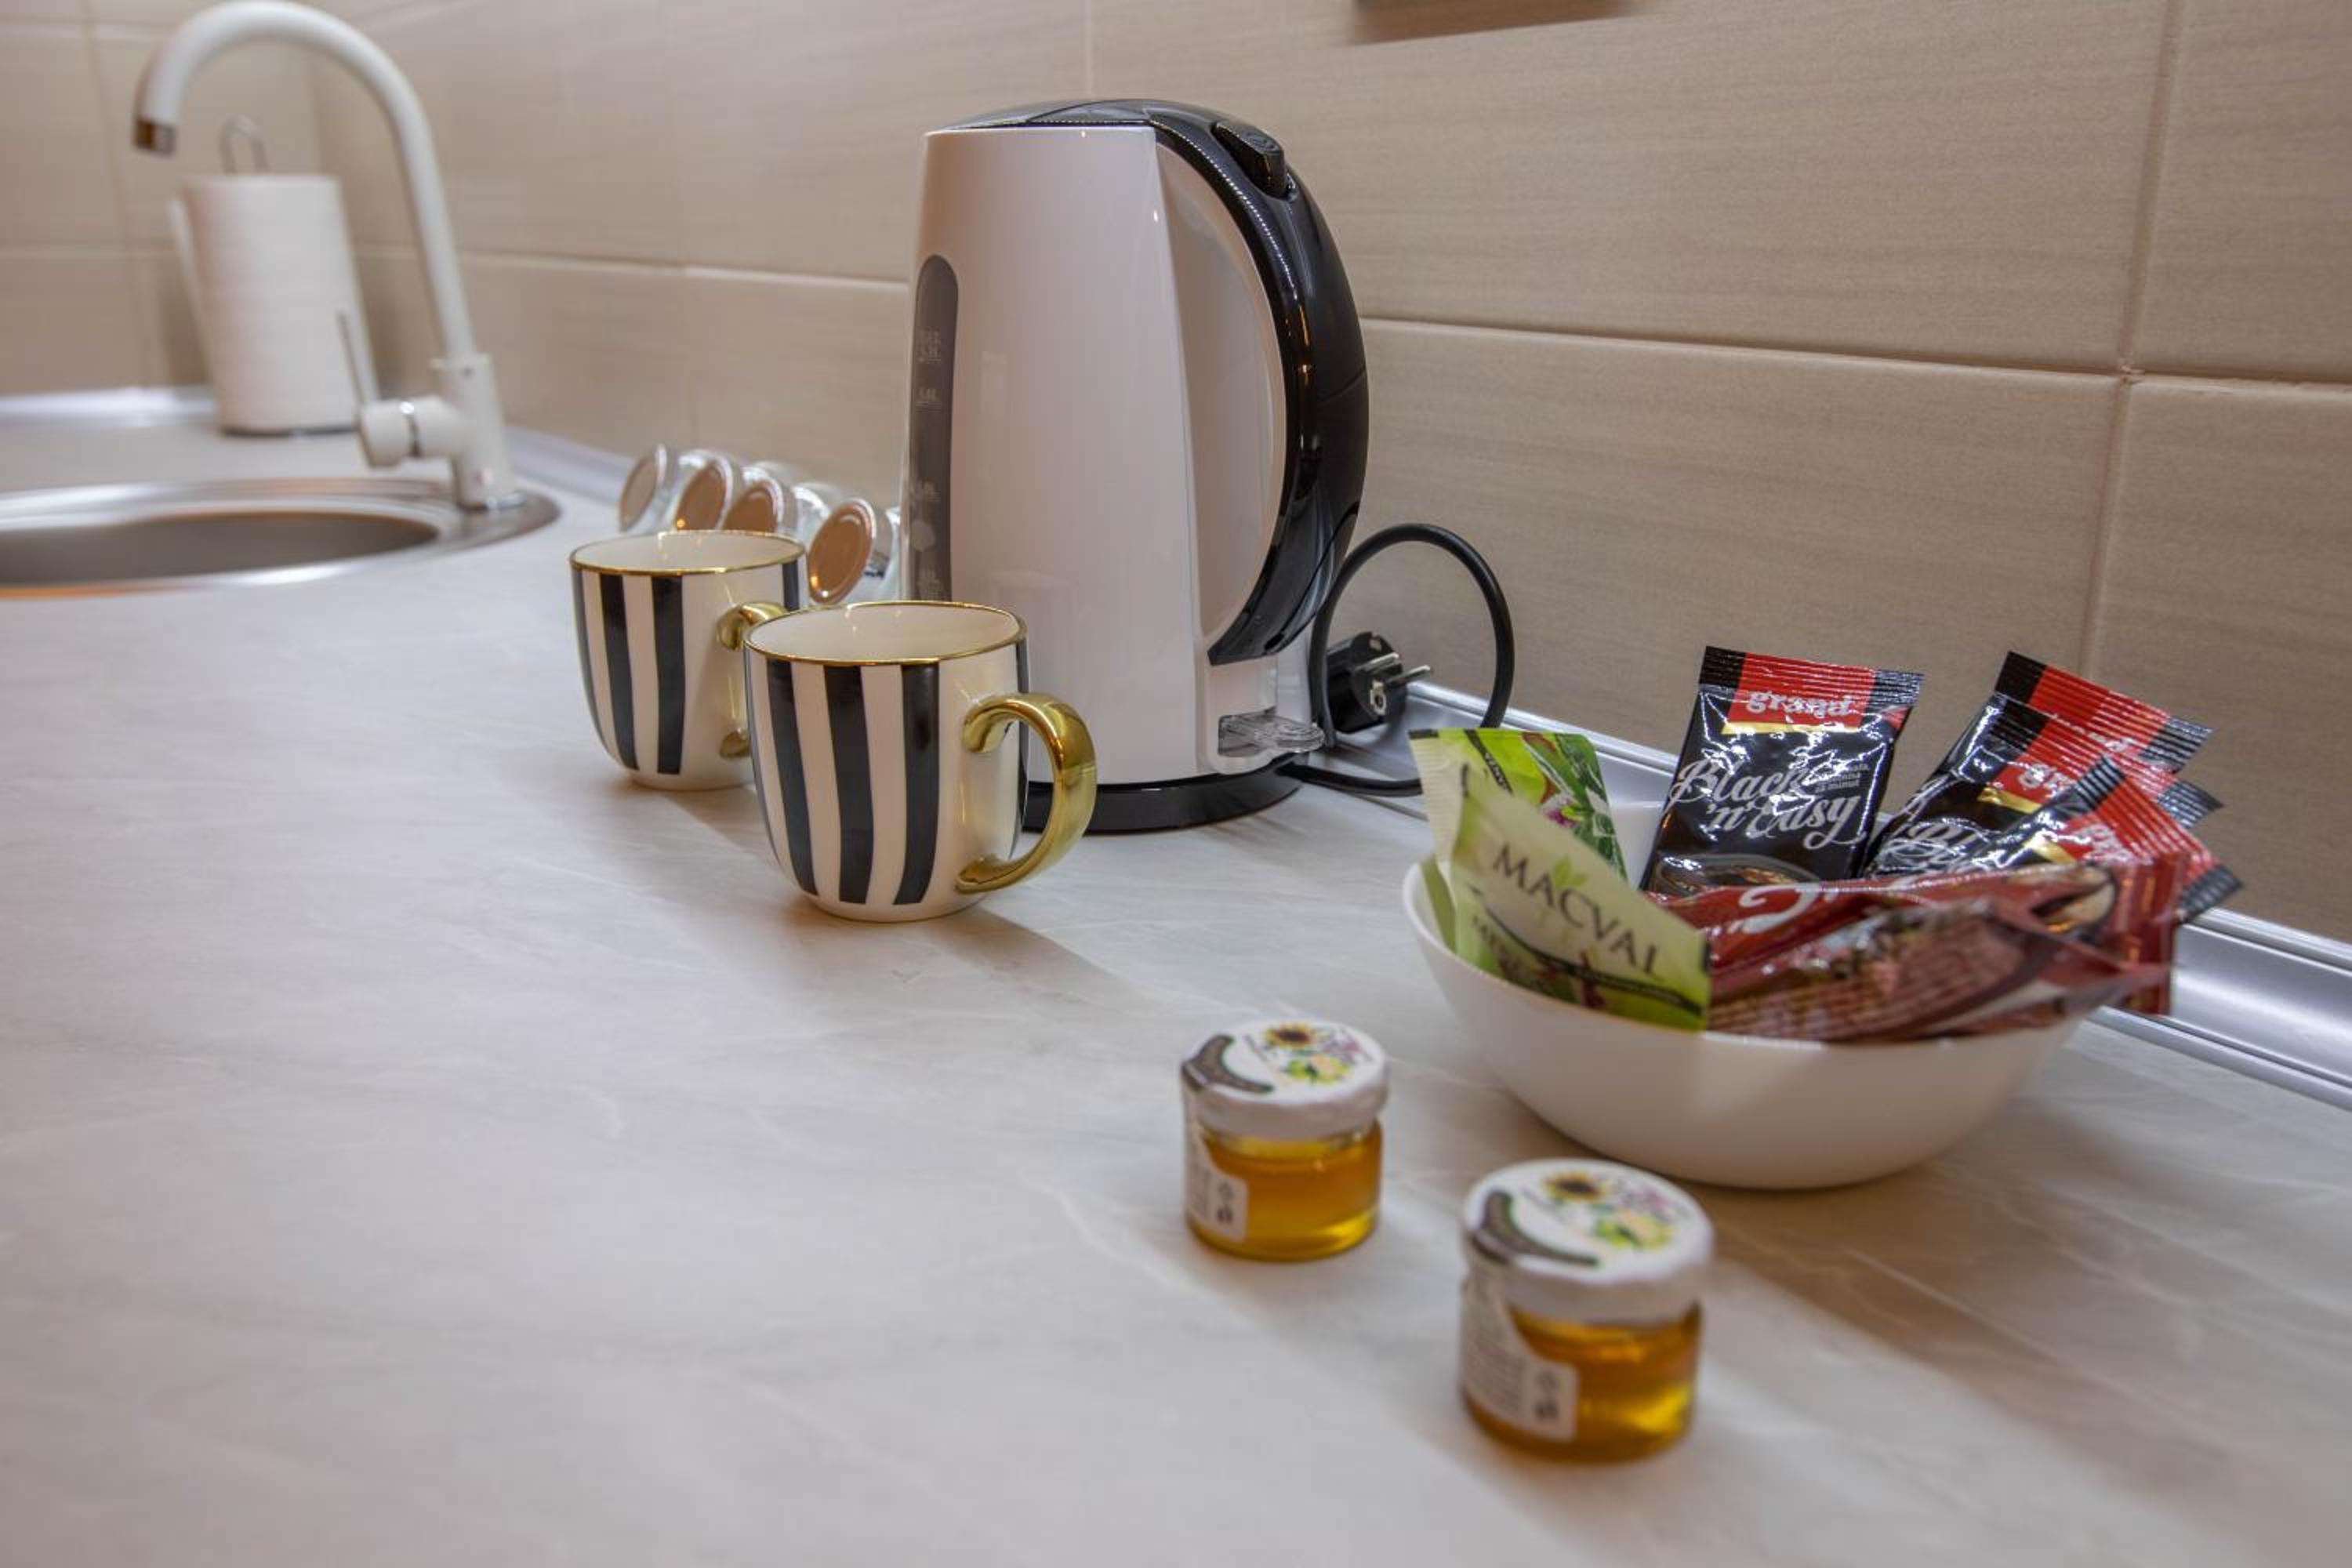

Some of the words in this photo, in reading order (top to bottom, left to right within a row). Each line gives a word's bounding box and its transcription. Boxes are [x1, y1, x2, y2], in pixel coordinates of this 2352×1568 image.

[1746, 690, 1856, 717] grand
[1664, 757, 1811, 809] Black
[1746, 795, 1866, 850] Easy
